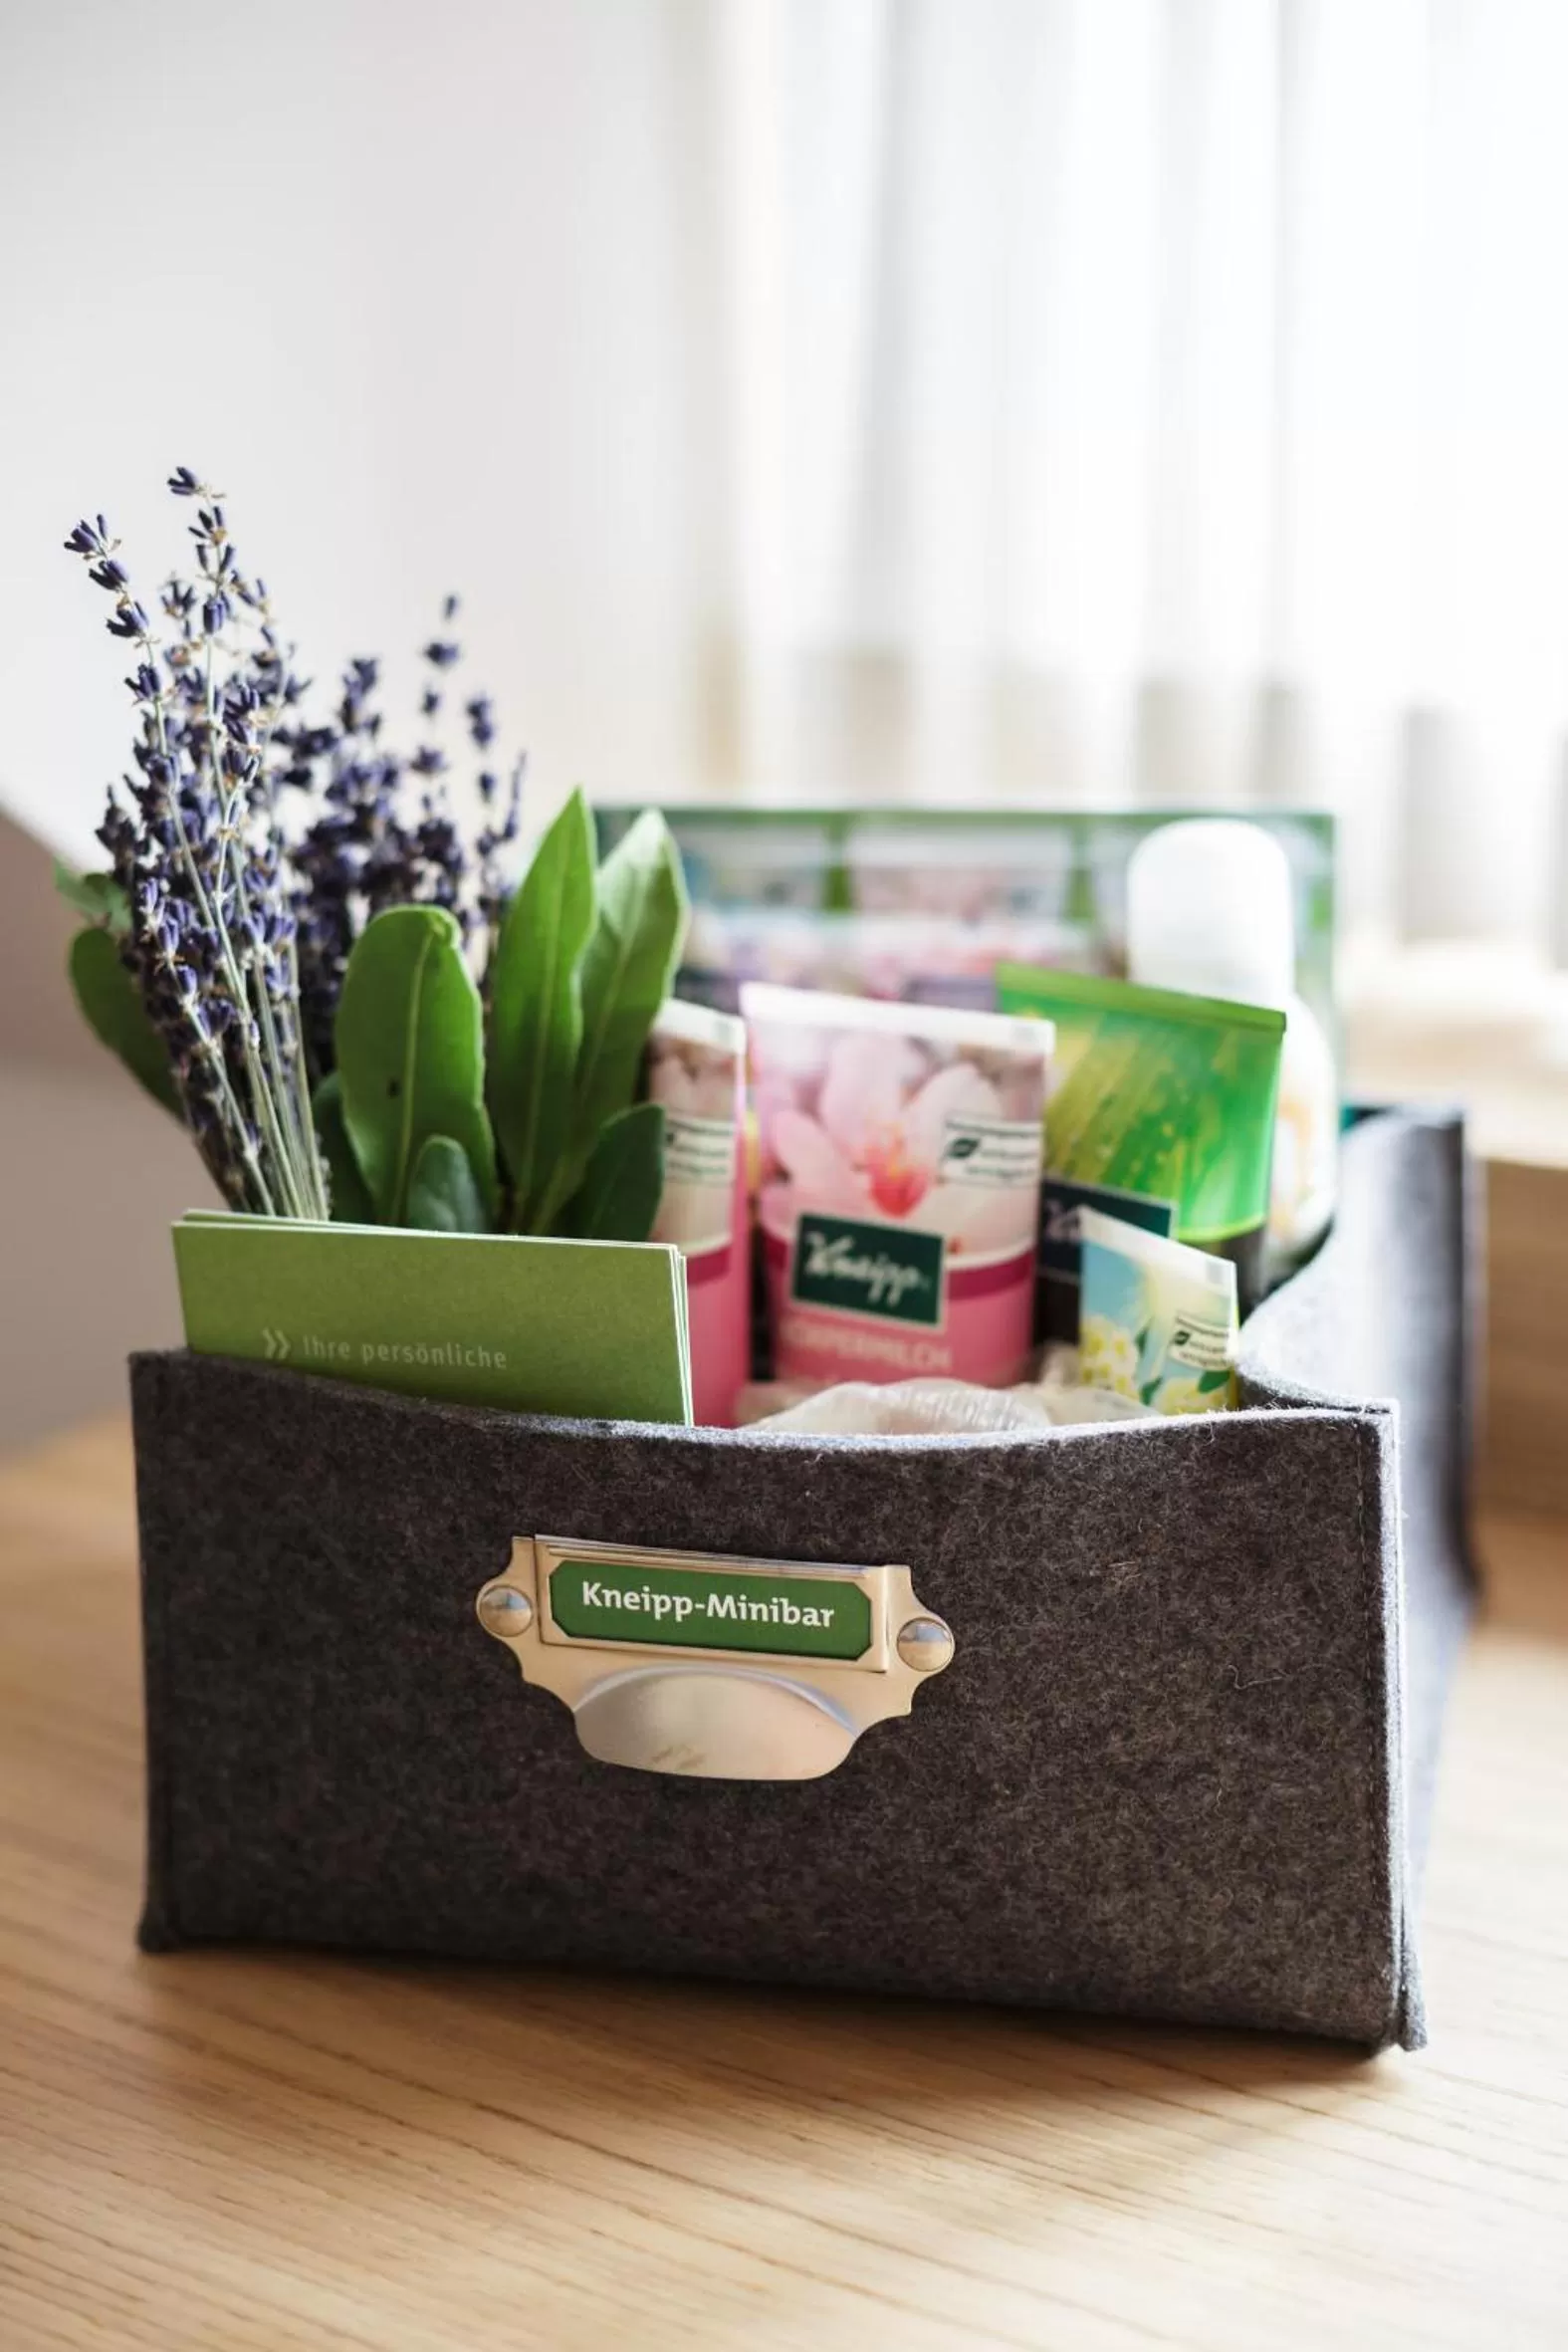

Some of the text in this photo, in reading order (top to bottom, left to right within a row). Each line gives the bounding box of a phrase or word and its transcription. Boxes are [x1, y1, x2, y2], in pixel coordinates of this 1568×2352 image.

[302, 1334, 507, 1369] Ihre persönliche
[581, 1580, 835, 1628] Kneipp-Minibar
